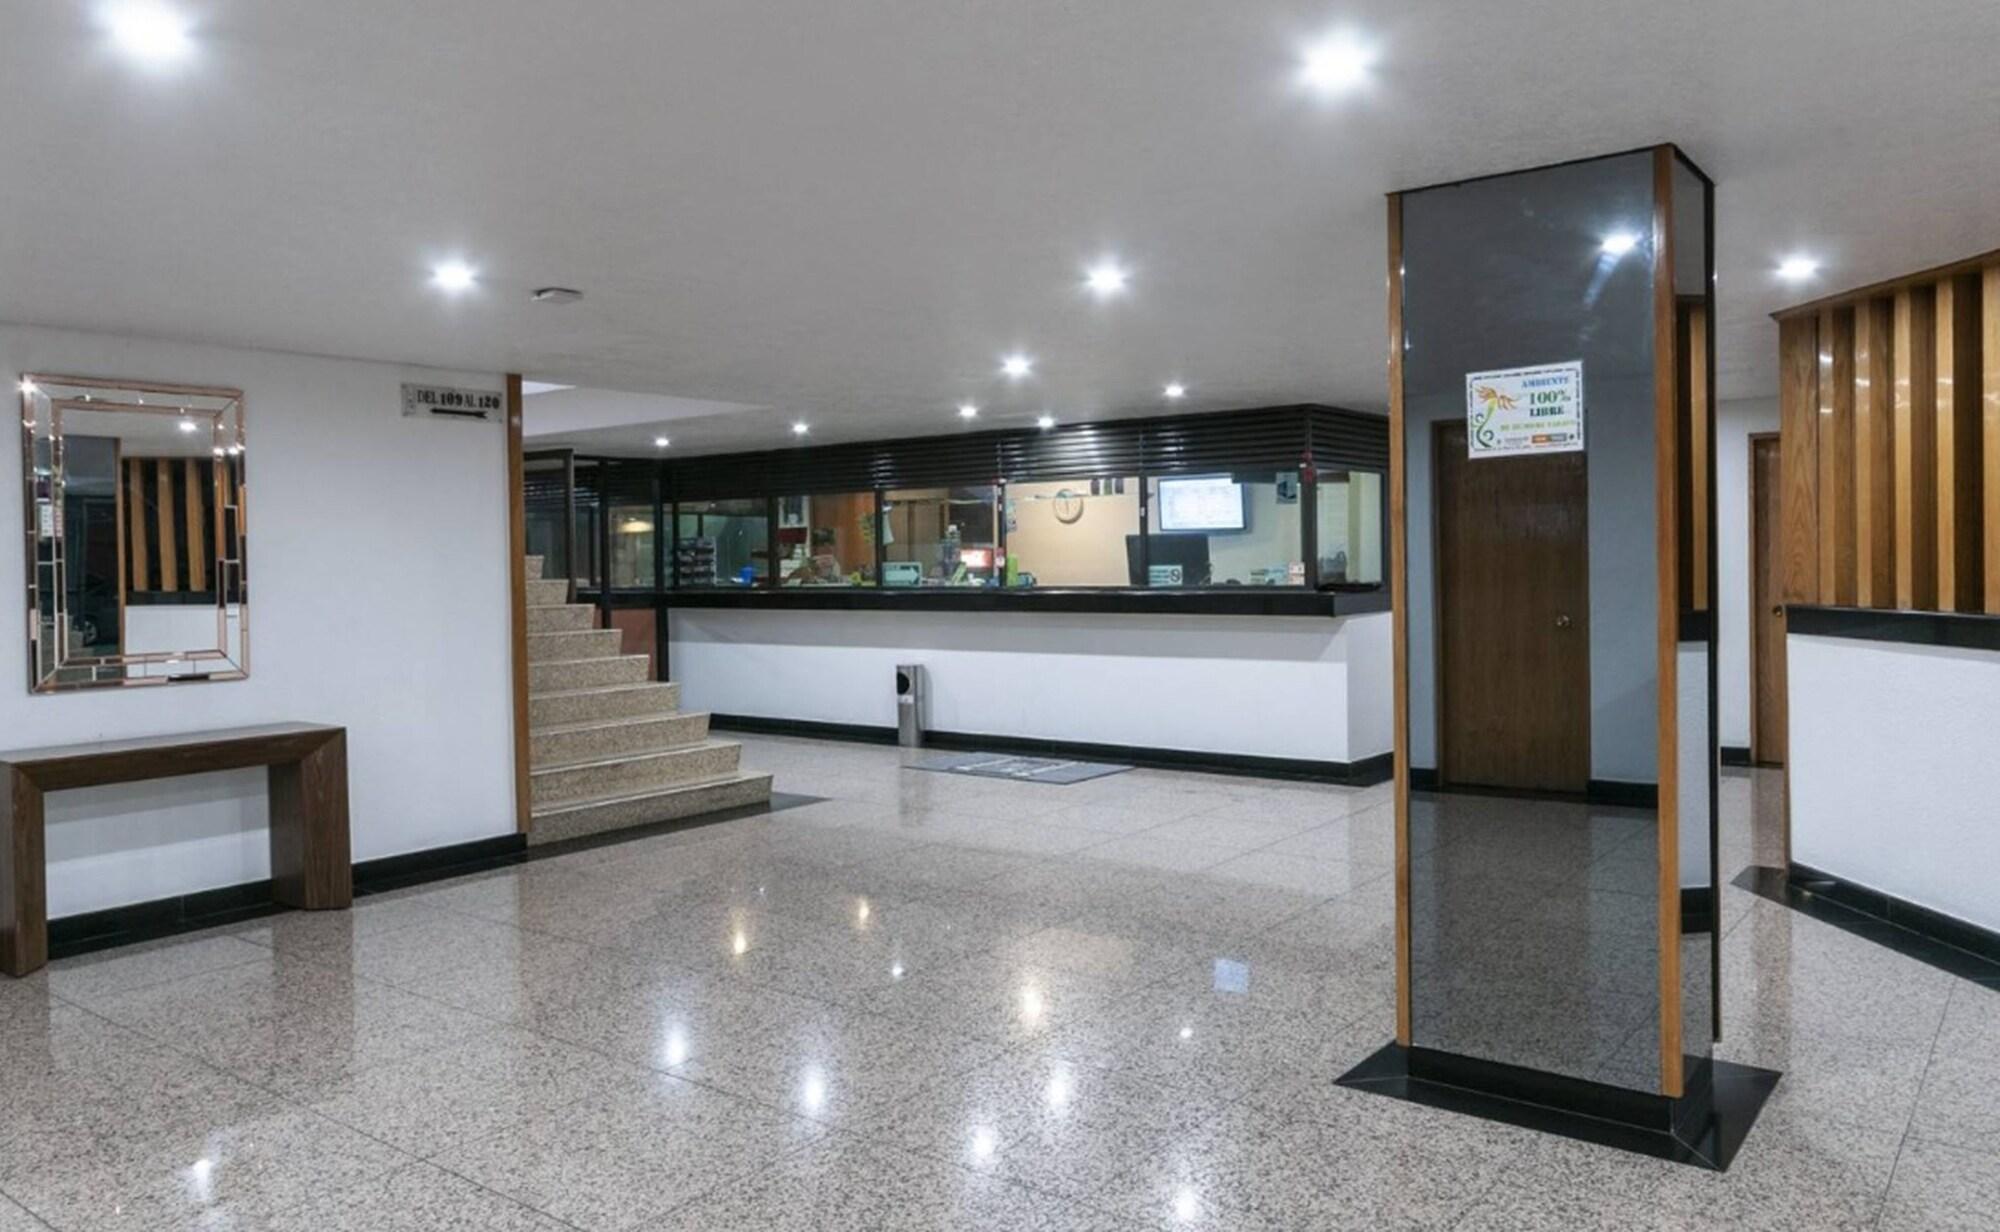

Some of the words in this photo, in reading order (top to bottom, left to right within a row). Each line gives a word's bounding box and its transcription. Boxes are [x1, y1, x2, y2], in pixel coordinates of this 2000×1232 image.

[417, 389, 438, 404] DEL
[440, 393, 463, 406] 109
[464, 394, 477, 407] AL
[478, 396, 500, 409] 120
[1529, 389, 1571, 405] 100%
[1529, 406, 1565, 417] LIBRE
